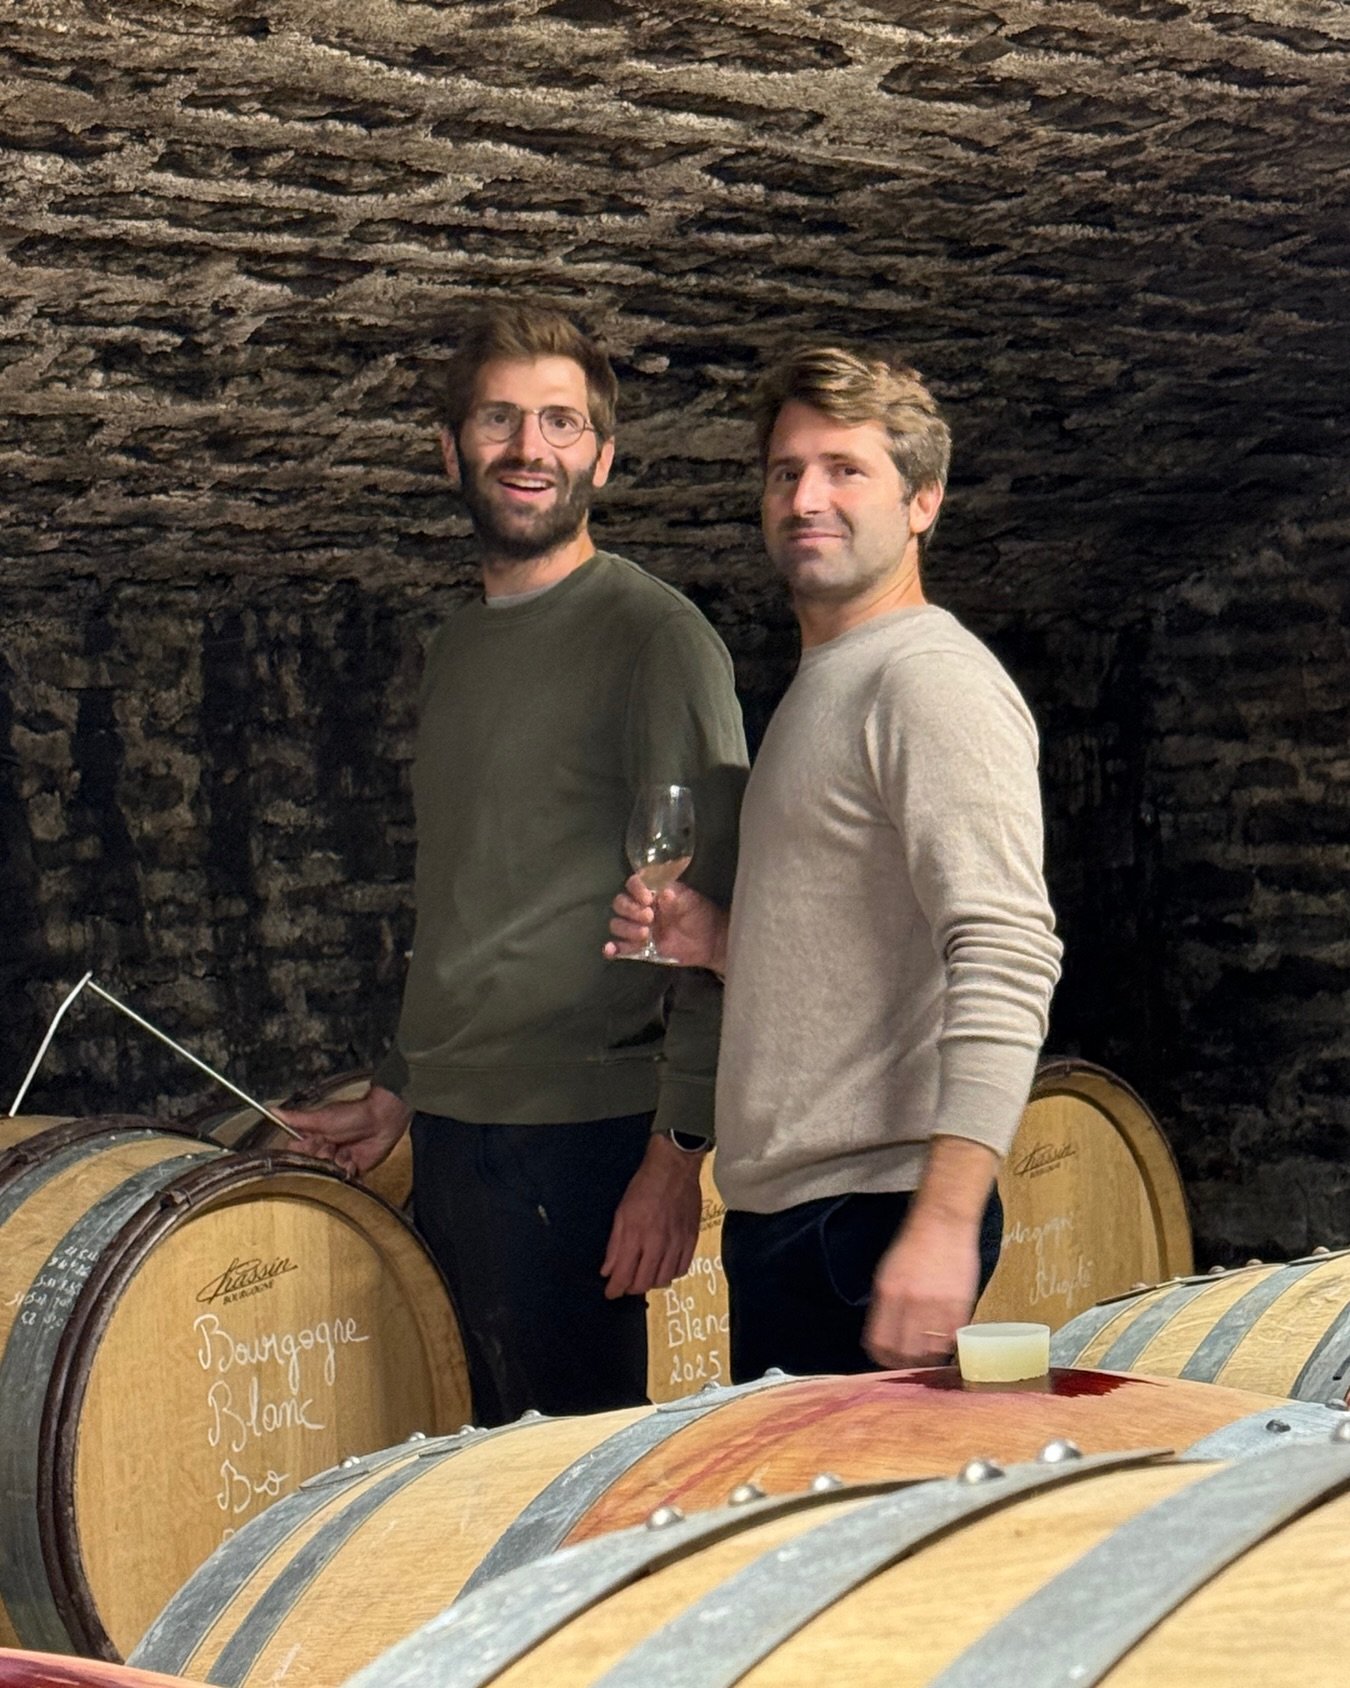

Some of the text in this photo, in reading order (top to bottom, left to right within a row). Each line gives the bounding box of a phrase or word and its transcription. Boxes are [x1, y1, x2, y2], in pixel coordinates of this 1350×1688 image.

[664, 1288, 695, 1316] Bio
[667, 1308, 730, 1348] Blanc
[193, 1313, 370, 1396] Bourgogne
[669, 1350, 723, 1385] 2025
[207, 1376, 326, 1453] Blanc
[217, 1459, 291, 1514] Bio
